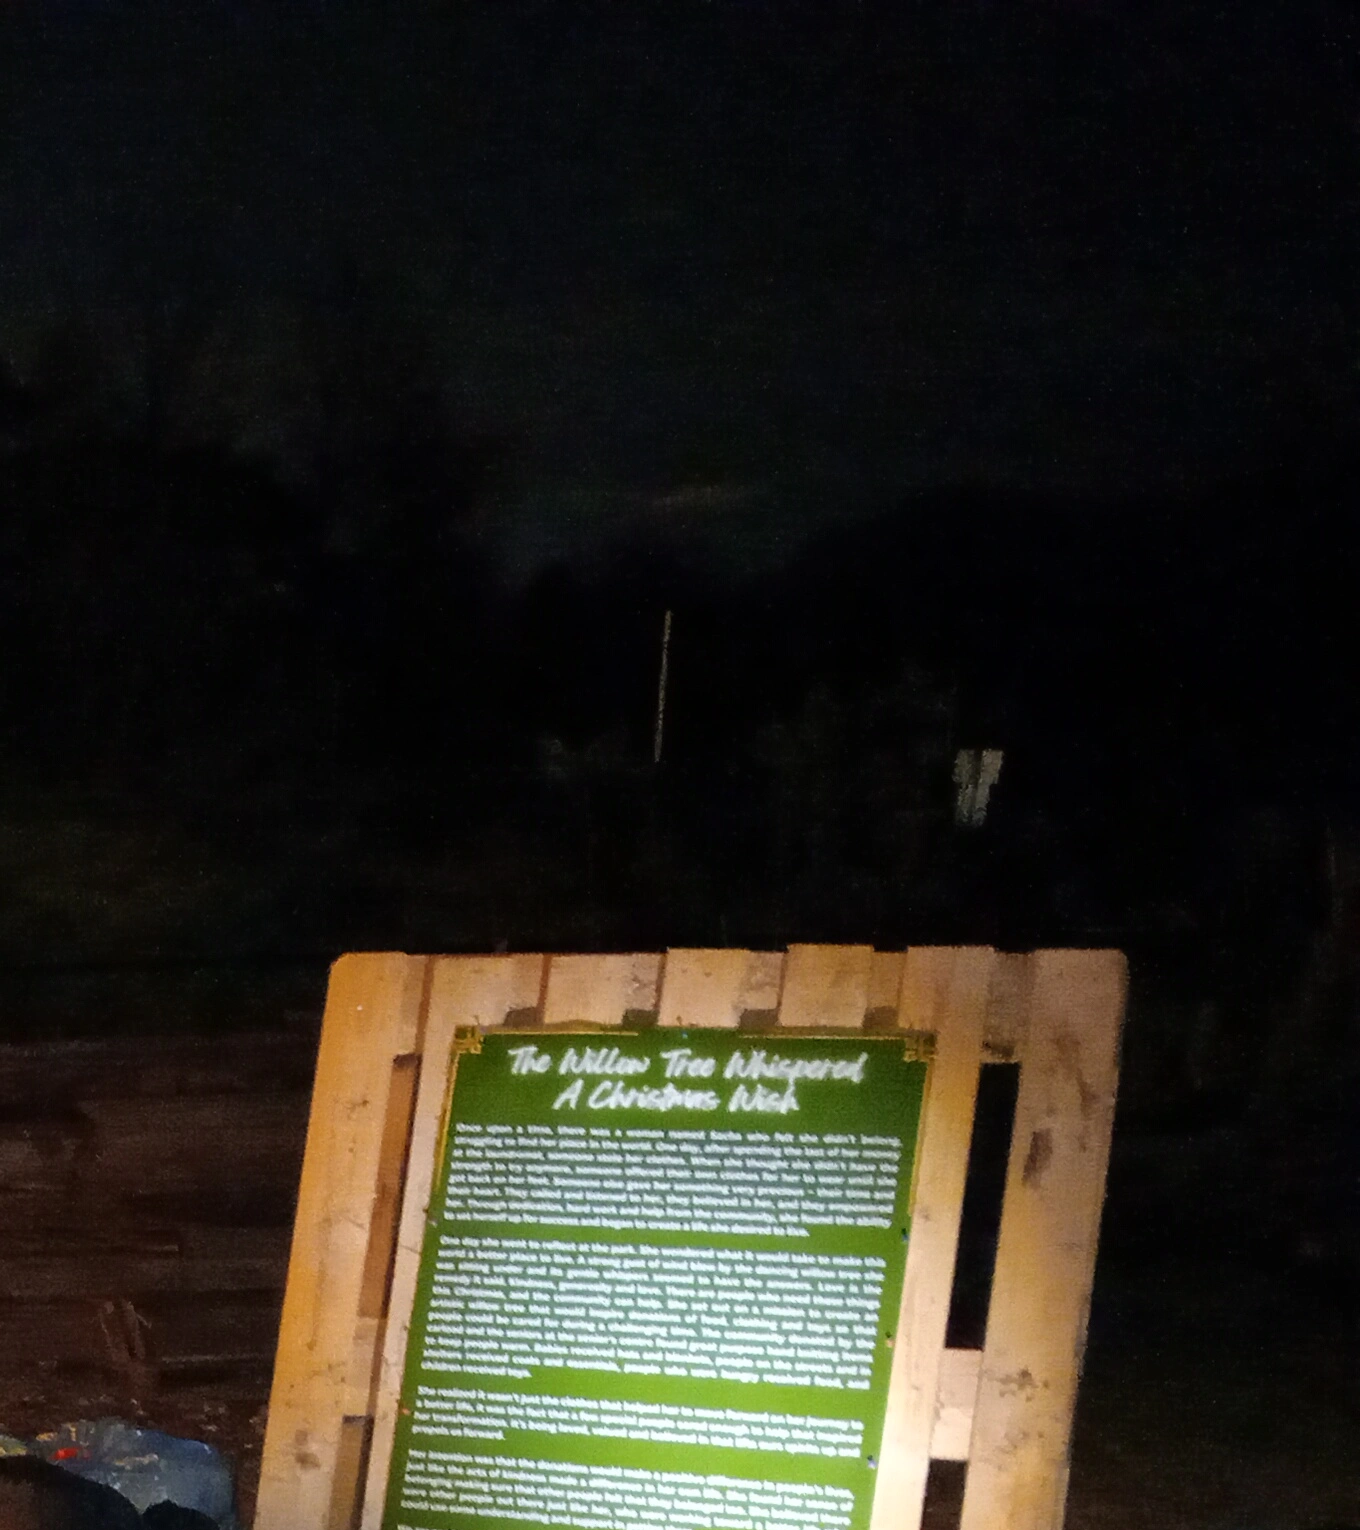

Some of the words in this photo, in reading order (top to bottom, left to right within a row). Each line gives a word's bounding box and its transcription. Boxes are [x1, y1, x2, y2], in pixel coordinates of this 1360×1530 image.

[508, 1045, 552, 1075] The
[559, 1047, 650, 1076] Willow
[660, 1048, 716, 1078] Tree
[724, 1047, 870, 1083] Whispered
[552, 1079, 584, 1110] A
[588, 1080, 720, 1111] Christmas
[728, 1082, 800, 1115] Wish
